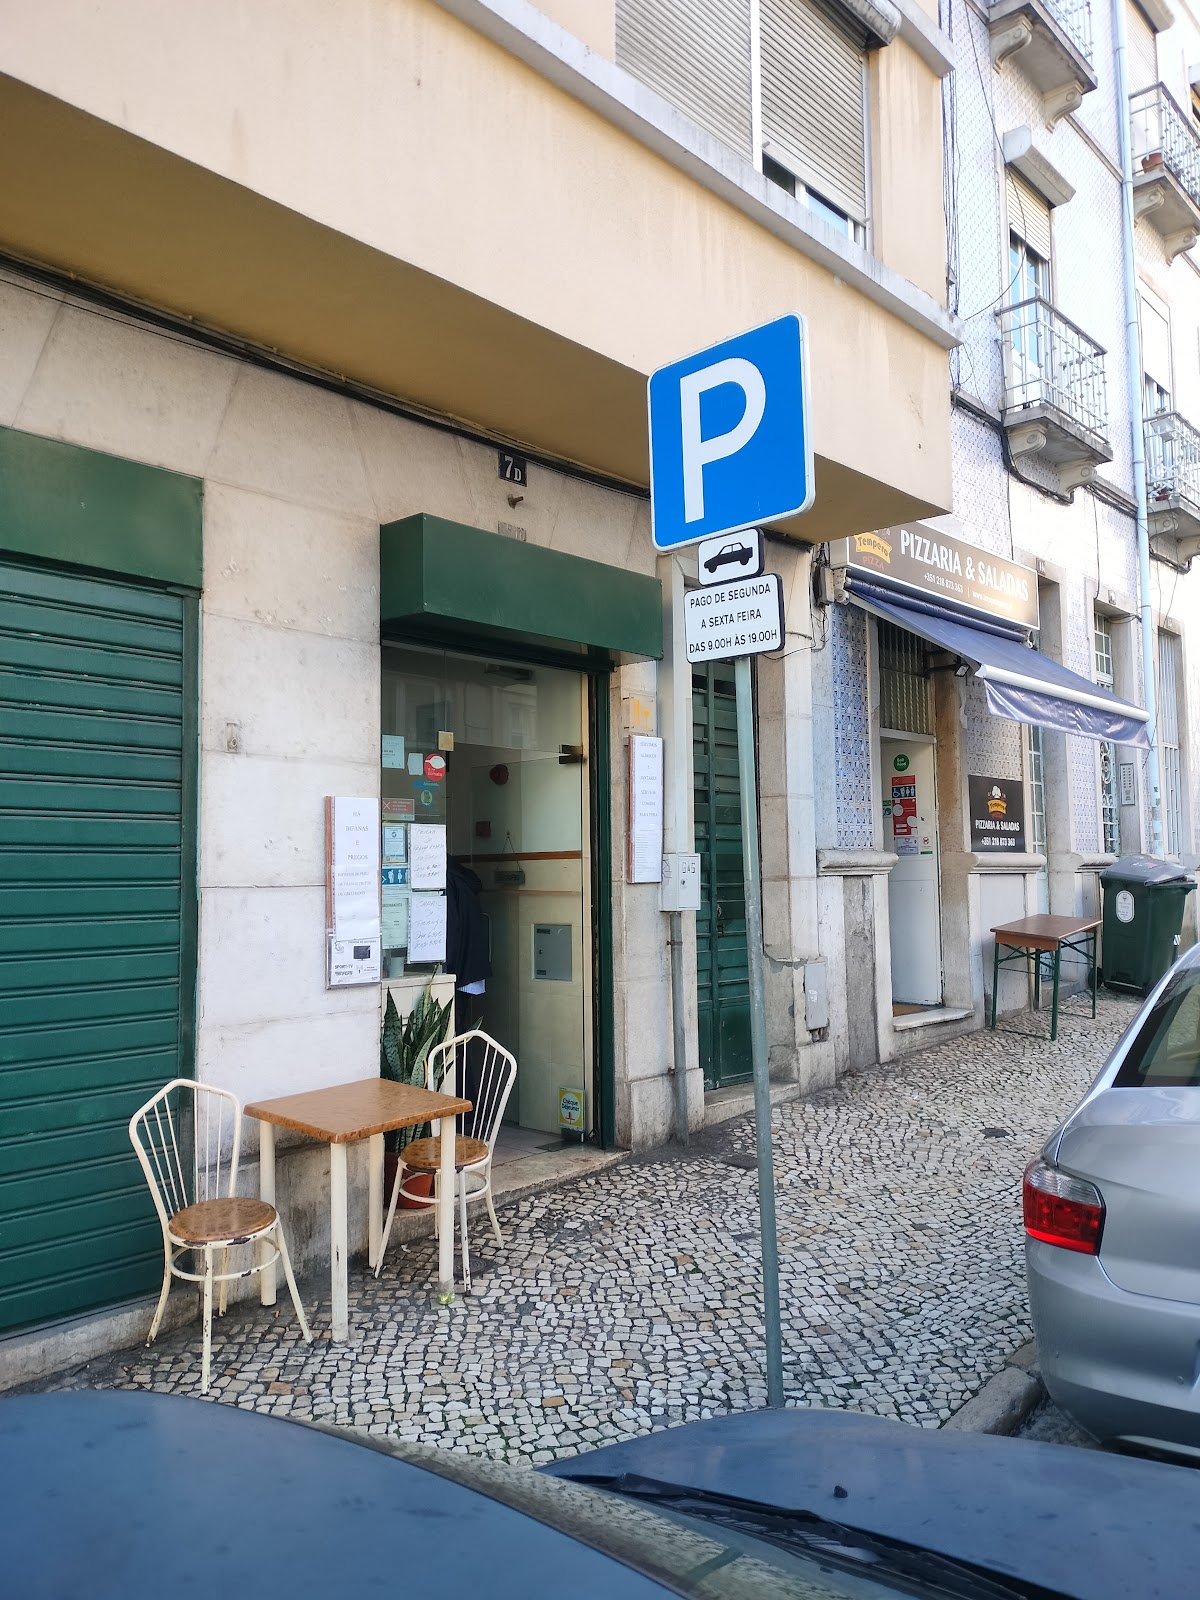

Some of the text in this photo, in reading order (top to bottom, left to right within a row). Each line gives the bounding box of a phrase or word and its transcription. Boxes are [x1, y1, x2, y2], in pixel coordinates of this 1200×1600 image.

[680, 357, 766, 524] P
[504, 454, 522, 482] 7D
[857, 537, 888, 557] Tempero
[862, 556, 885, 571] PIZZA
[900, 529, 962, 577] PIZZARIA
[965, 556, 975, 582] &
[978, 561, 1029, 602] SALADAS
[924, 572, 936, 584] +351
[690, 583, 771, 608] PAGO DE SEGUNDA
[701, 608, 762, 629] A SEXTA FEIRA
[689, 629, 777, 654] DAS 9.00H ÀS 19.00H
[975, 819, 1020, 832] PIZZARIA & SALADAS
[981, 837, 991, 846] +351
[682, 861, 696, 874] GAS
